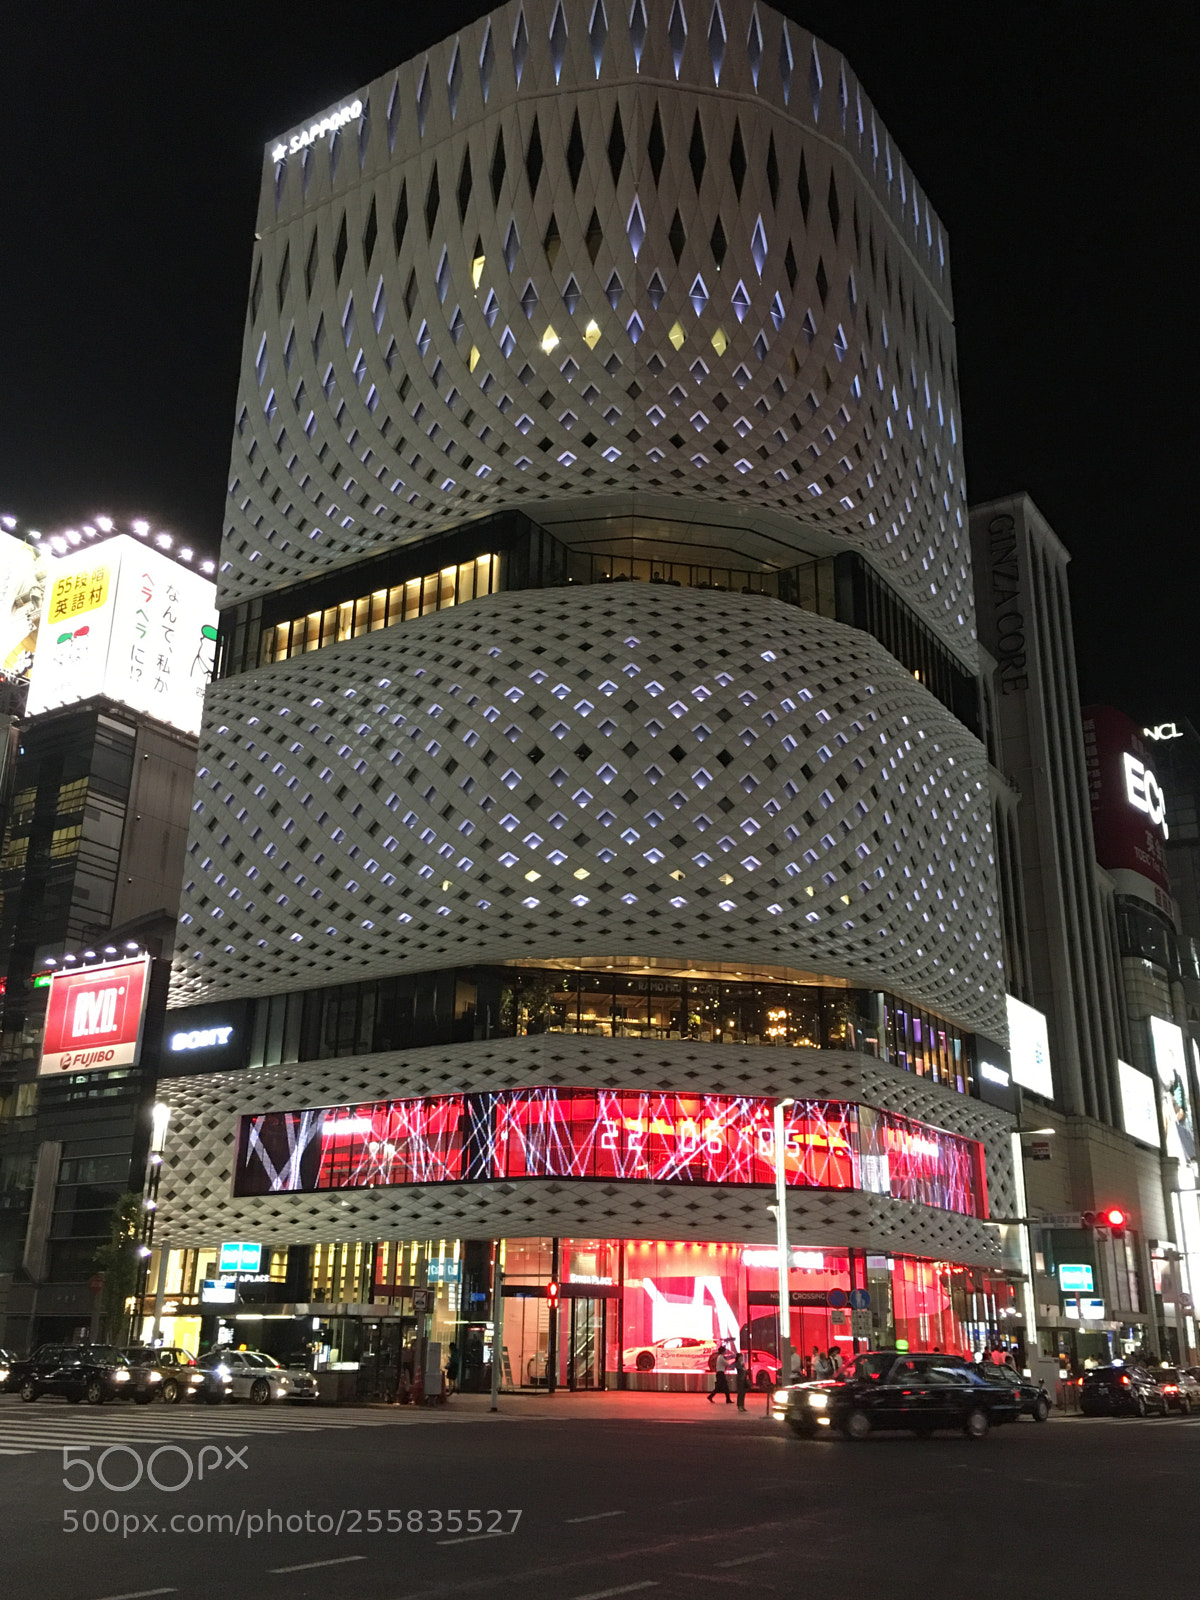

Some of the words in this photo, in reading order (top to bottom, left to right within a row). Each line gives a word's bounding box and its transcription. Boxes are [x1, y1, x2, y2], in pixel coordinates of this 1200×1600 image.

[289, 100, 362, 154] SAPPORO
[988, 513, 1020, 609] GINZA
[54, 585, 103, 618] 英語村
[995, 615, 1029, 696] CORE
[171, 1026, 233, 1051] SONY
[73, 1049, 115, 1068] FUJIBO
[792, 1292, 826, 1301] CROSSING
